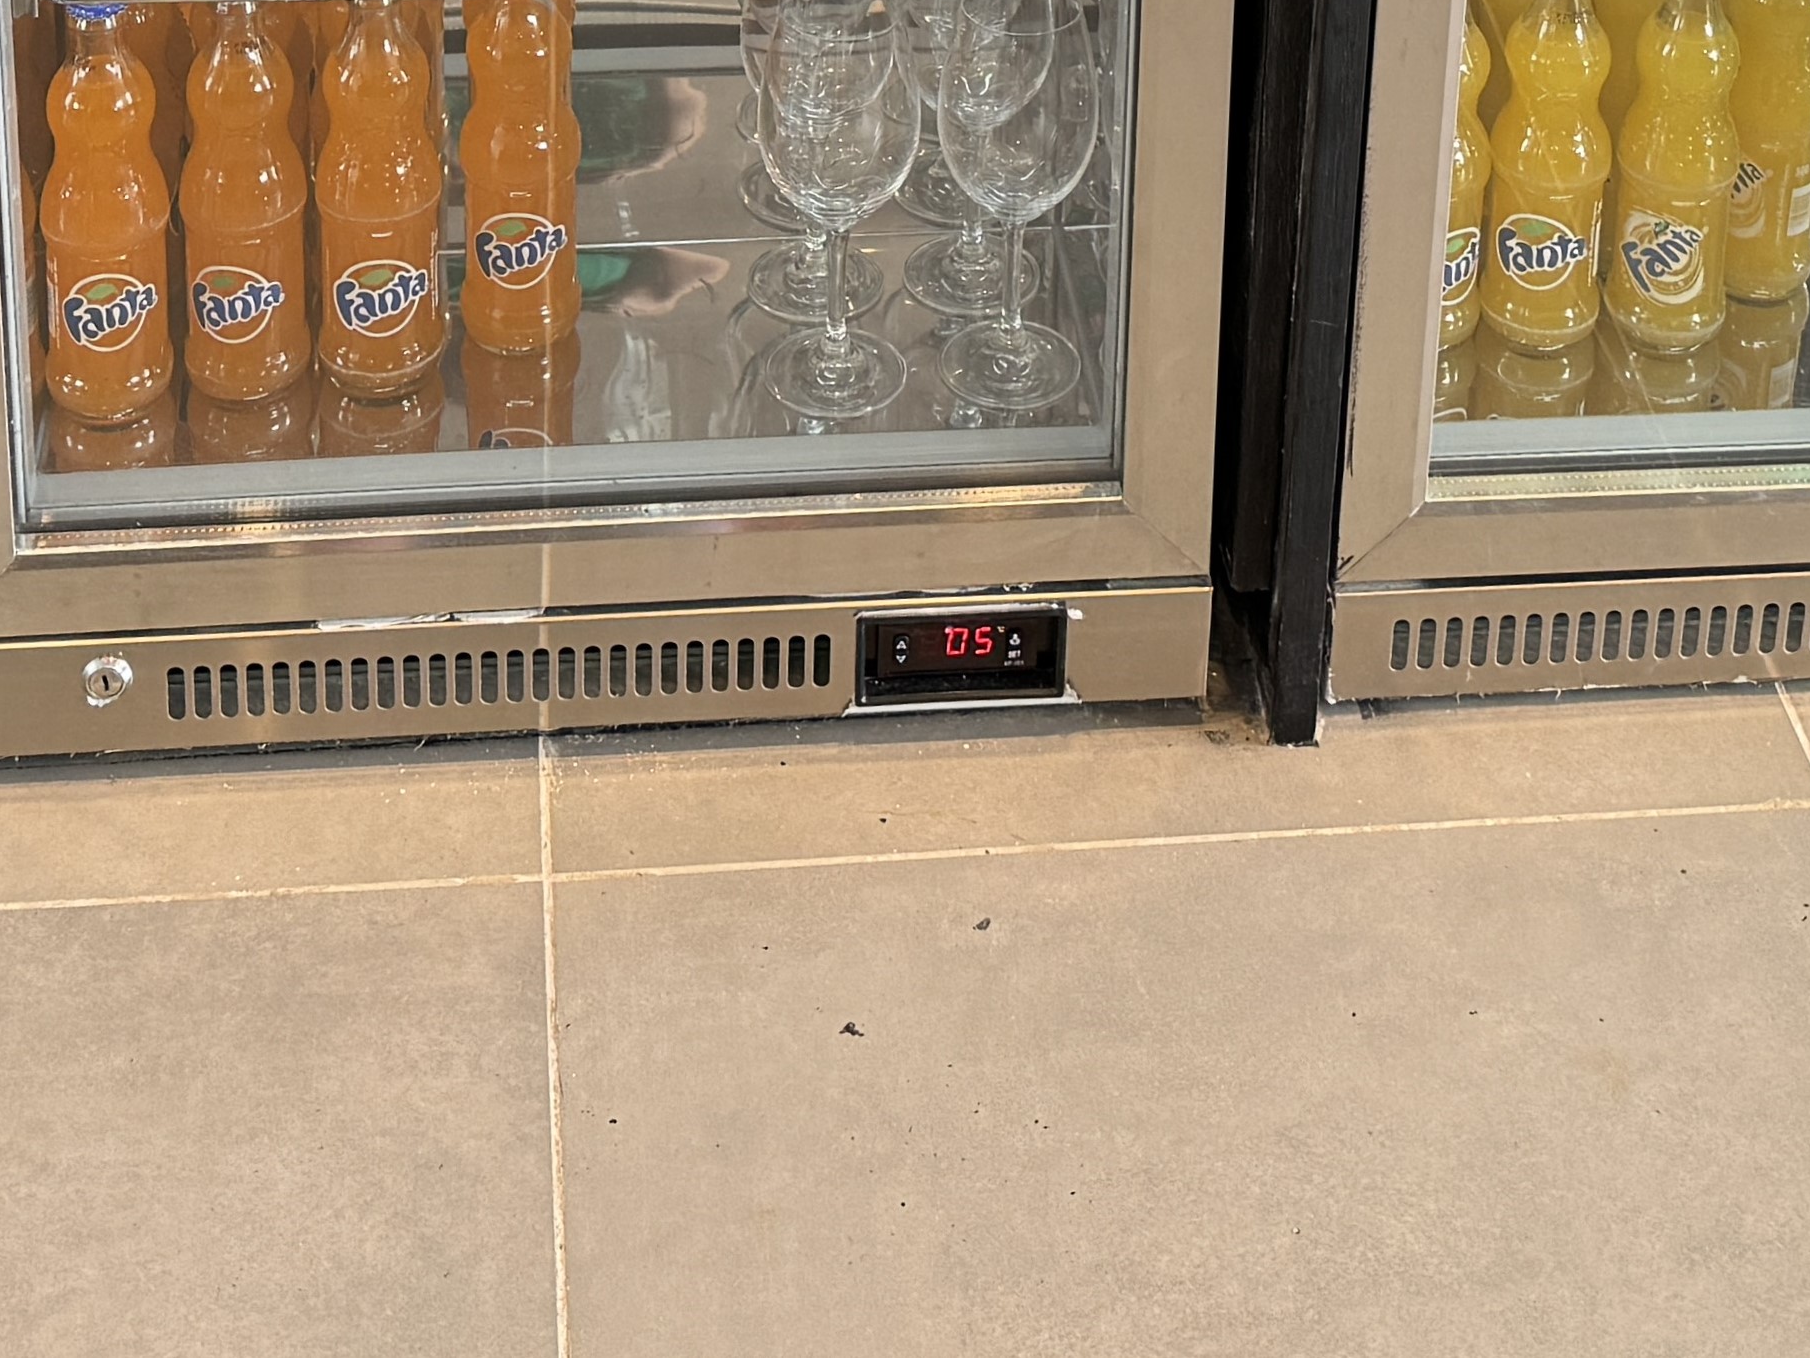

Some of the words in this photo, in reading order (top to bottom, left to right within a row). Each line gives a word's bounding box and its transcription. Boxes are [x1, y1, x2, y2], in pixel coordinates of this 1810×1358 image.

[475, 222, 568, 279] Fanta
[1497, 227, 1586, 275] Fanta
[1620, 225, 1701, 296] Fanta
[63, 282, 158, 346] Fanta
[191, 278, 285, 332] Fanta
[334, 268, 429, 324] Fanta
[944, 625, 993, 657] 05
[1007, 649, 1022, 659] SET
